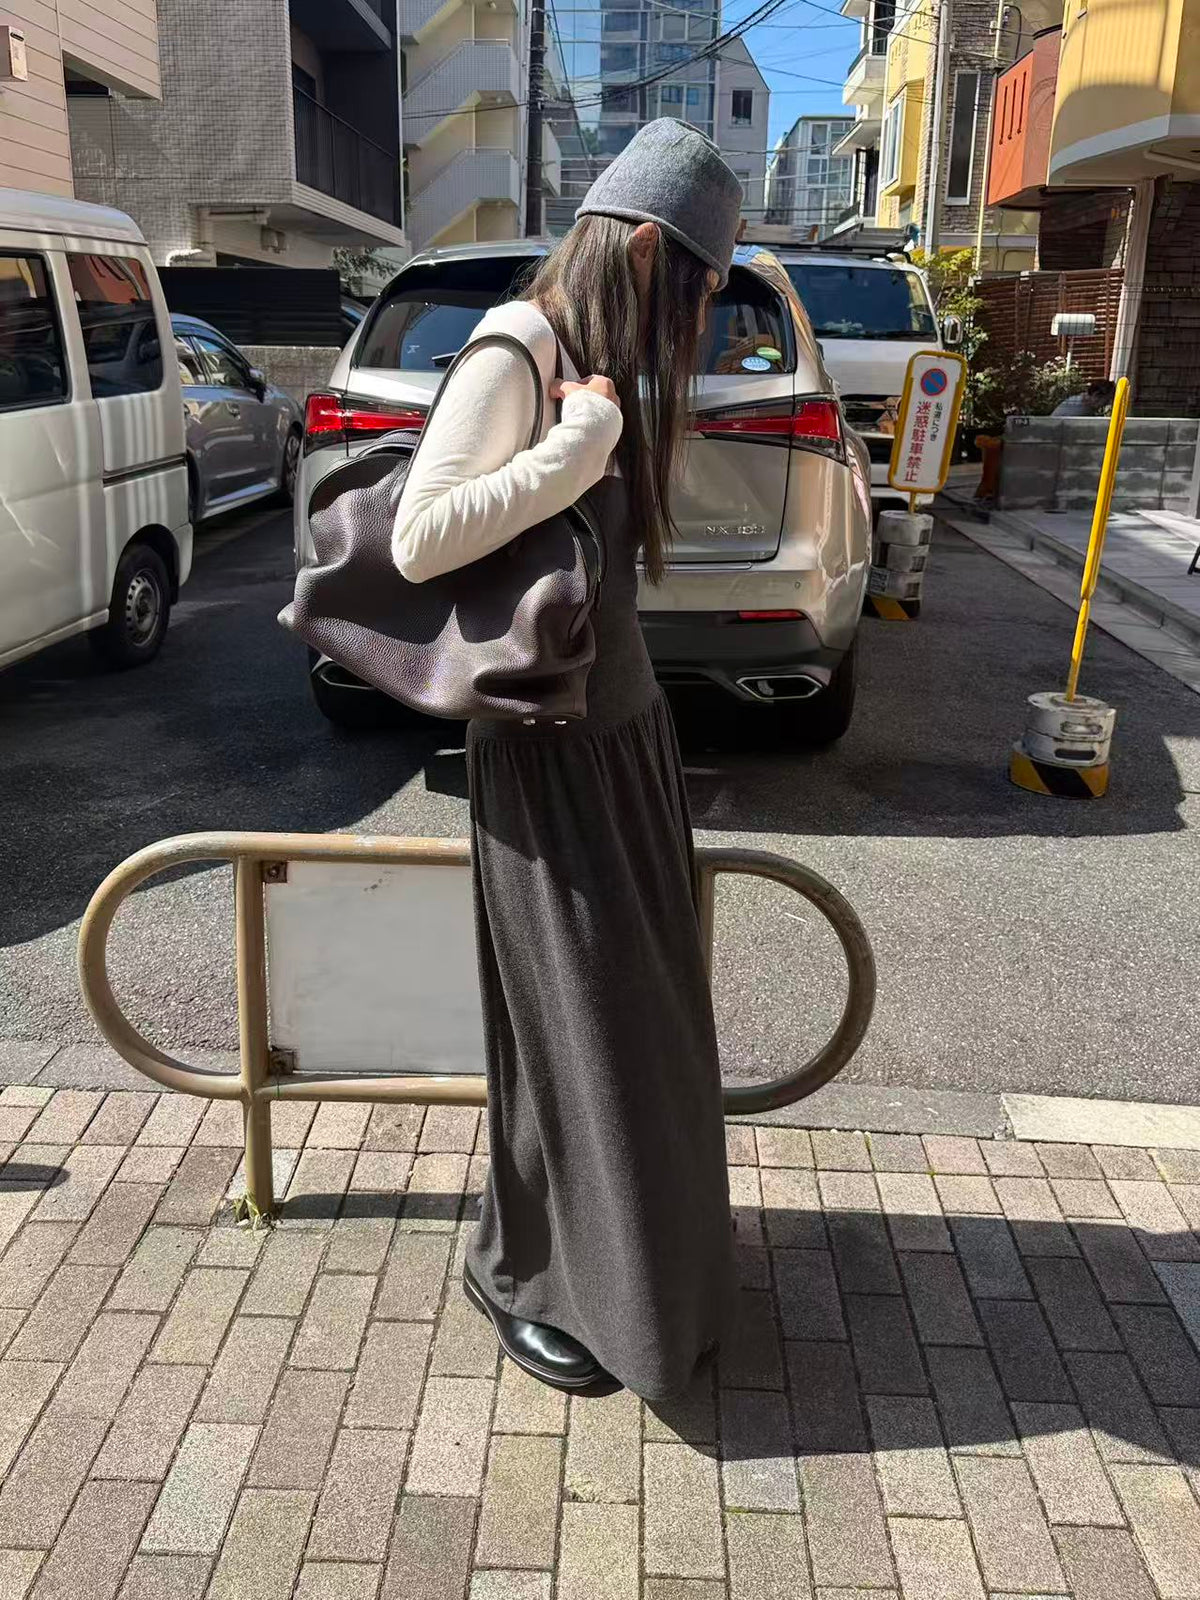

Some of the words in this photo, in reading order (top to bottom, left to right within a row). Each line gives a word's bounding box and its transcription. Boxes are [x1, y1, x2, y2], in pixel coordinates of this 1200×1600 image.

[904, 400, 931, 482] 迷惑駐車禁止
[930, 402, 943, 442] 私道につき
[706, 525, 730, 535] NX
